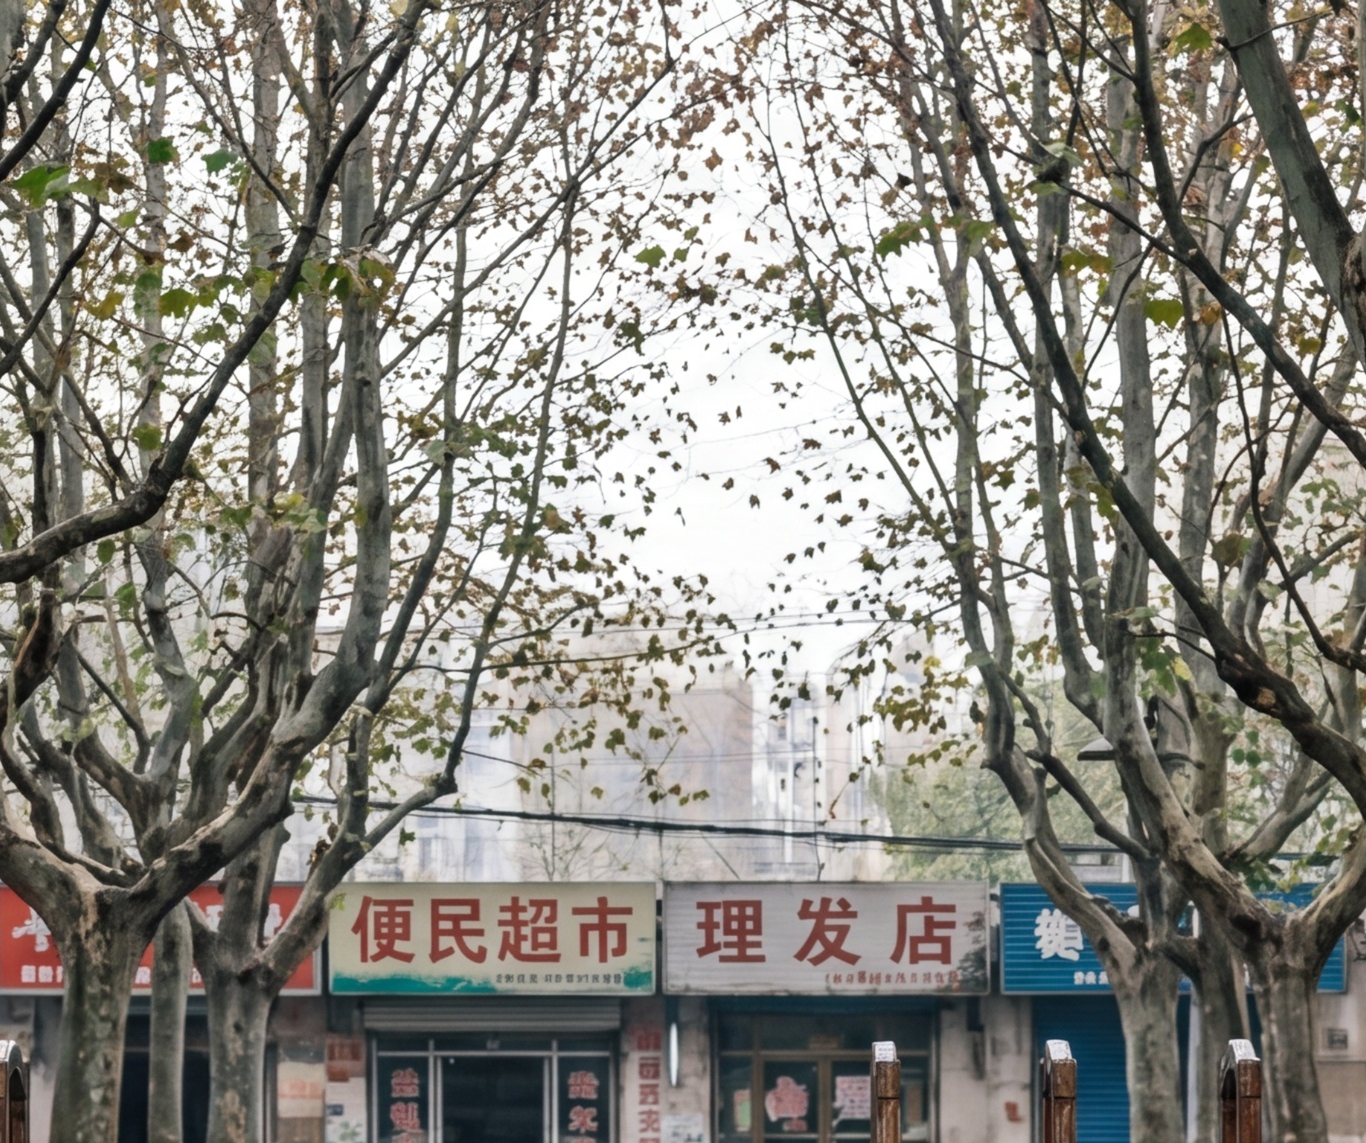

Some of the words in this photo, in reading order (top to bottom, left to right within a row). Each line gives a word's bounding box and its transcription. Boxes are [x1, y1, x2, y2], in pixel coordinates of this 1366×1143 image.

[351, 896, 633, 965] 便民超市
[696, 896, 957, 967] 理发店
